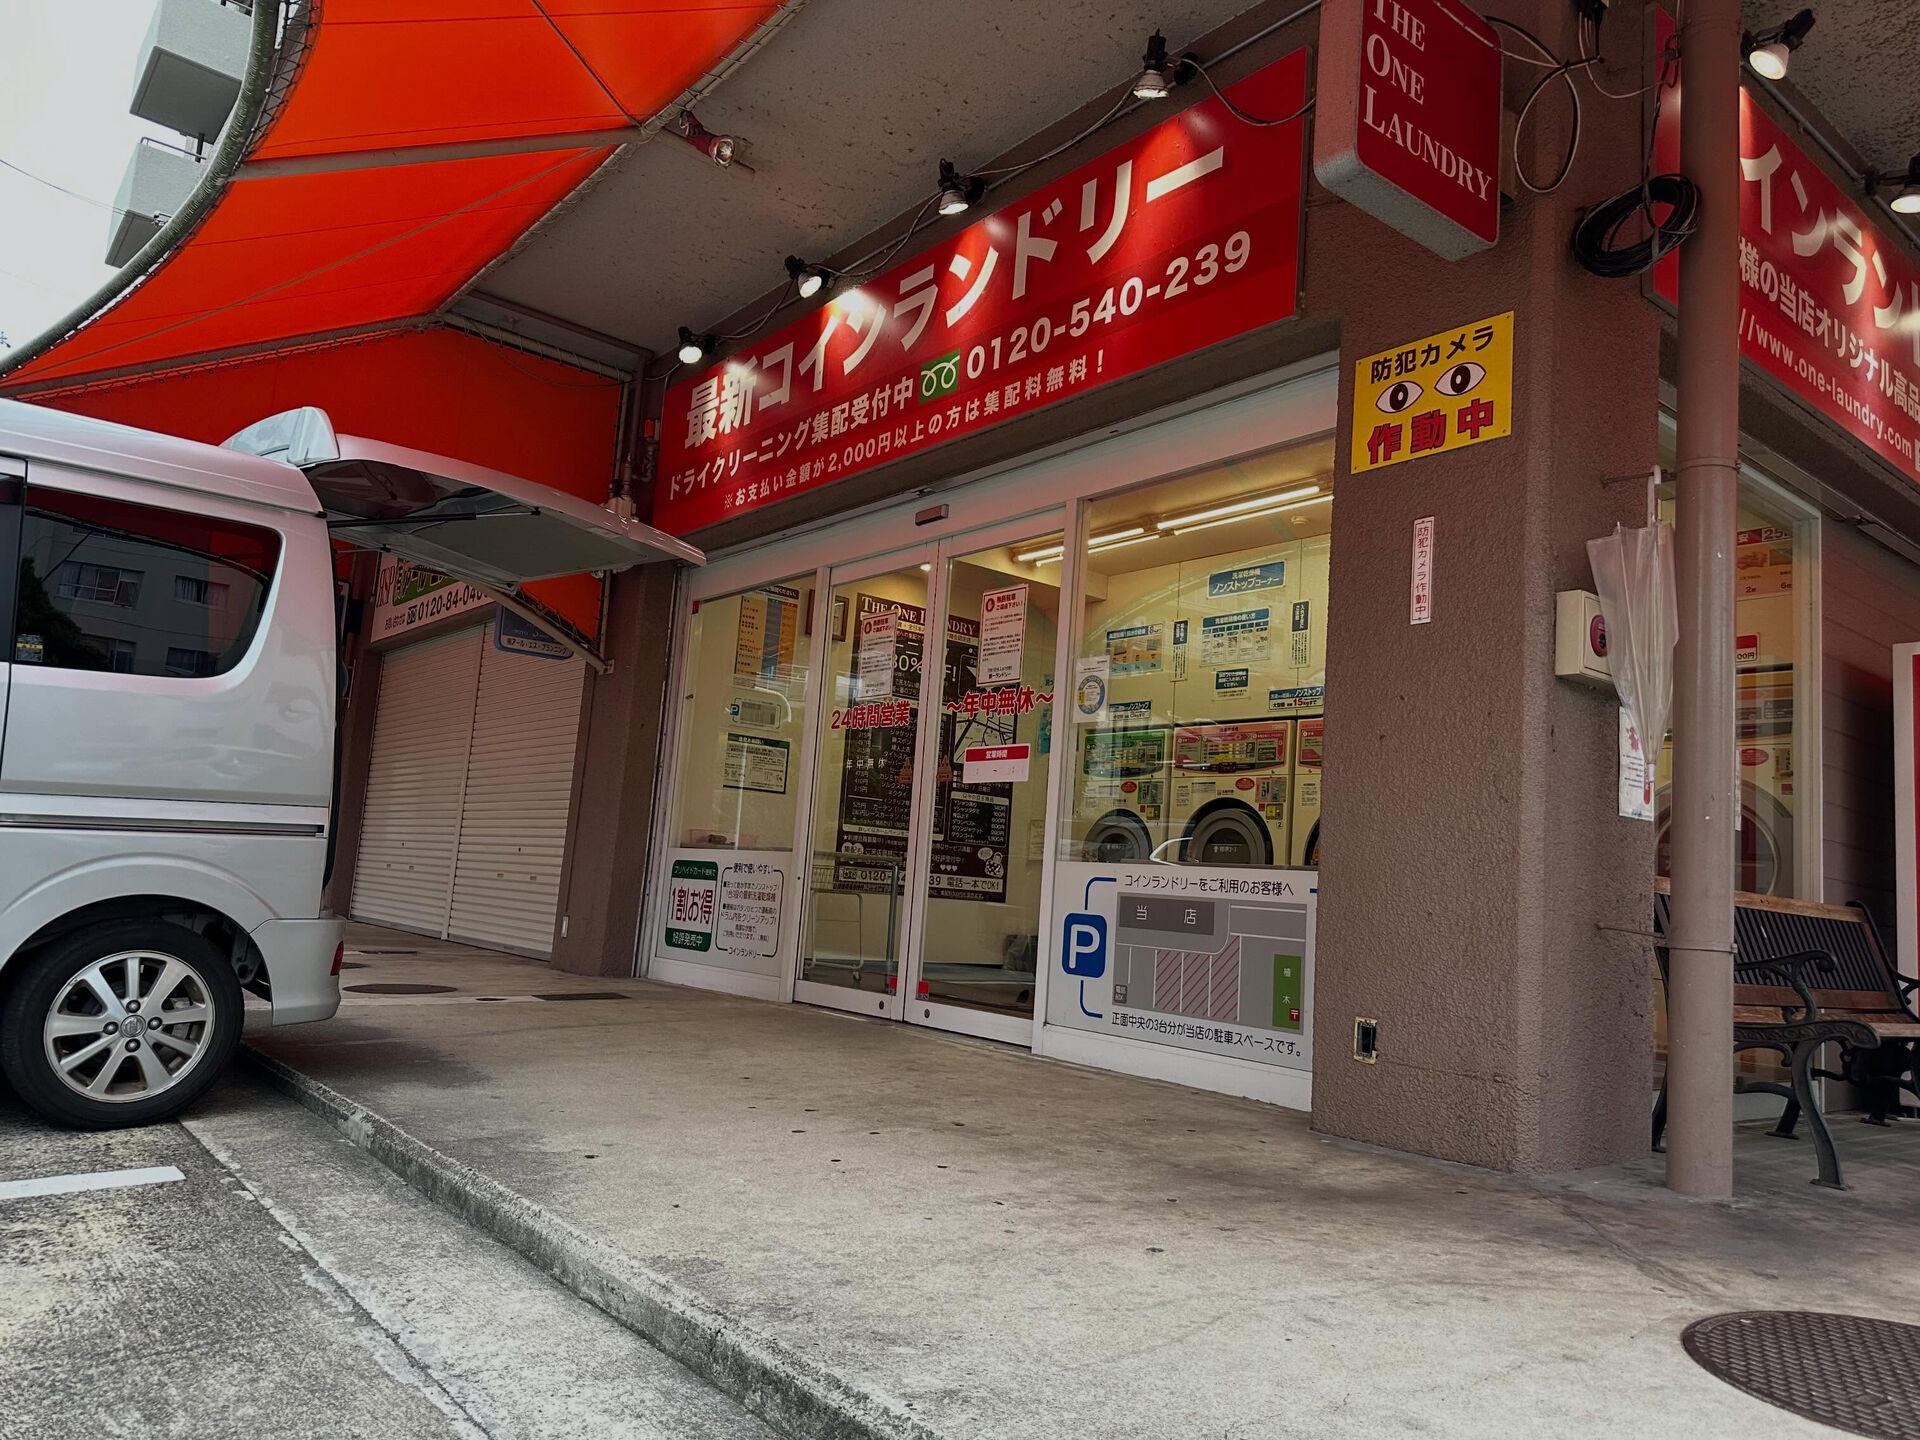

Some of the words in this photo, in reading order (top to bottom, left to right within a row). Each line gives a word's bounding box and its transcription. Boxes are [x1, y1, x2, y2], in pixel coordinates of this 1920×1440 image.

[1374, 0, 1426, 52] THE
[1366, 33, 1425, 105] ONE
[1363, 83, 1492, 201] LAUNDRY
[684, 146, 1224, 450] 最新コインランドリー
[966, 230, 1252, 380] 0120-540-239
[1370, 324, 1494, 385] 防犯カメラ
[669, 375, 914, 501] ドライクリーニング集配受付中
[1366, 397, 1495, 466] 作動中
[1211, 577, 1280, 594] ノンストップコーナー
[1414, 526, 1430, 615] 防犯カメラ作動中
[831, 700, 911, 730] 24時間営業
[1123, 874, 1294, 896] コインランドリーをご利用のお客様へ
[727, 946, 761, 959] コインランドリー
[1069, 924, 1101, 969] P
[1111, 1011, 1302, 1057] 正面中央の3台分が当店の駐車スペースです。
